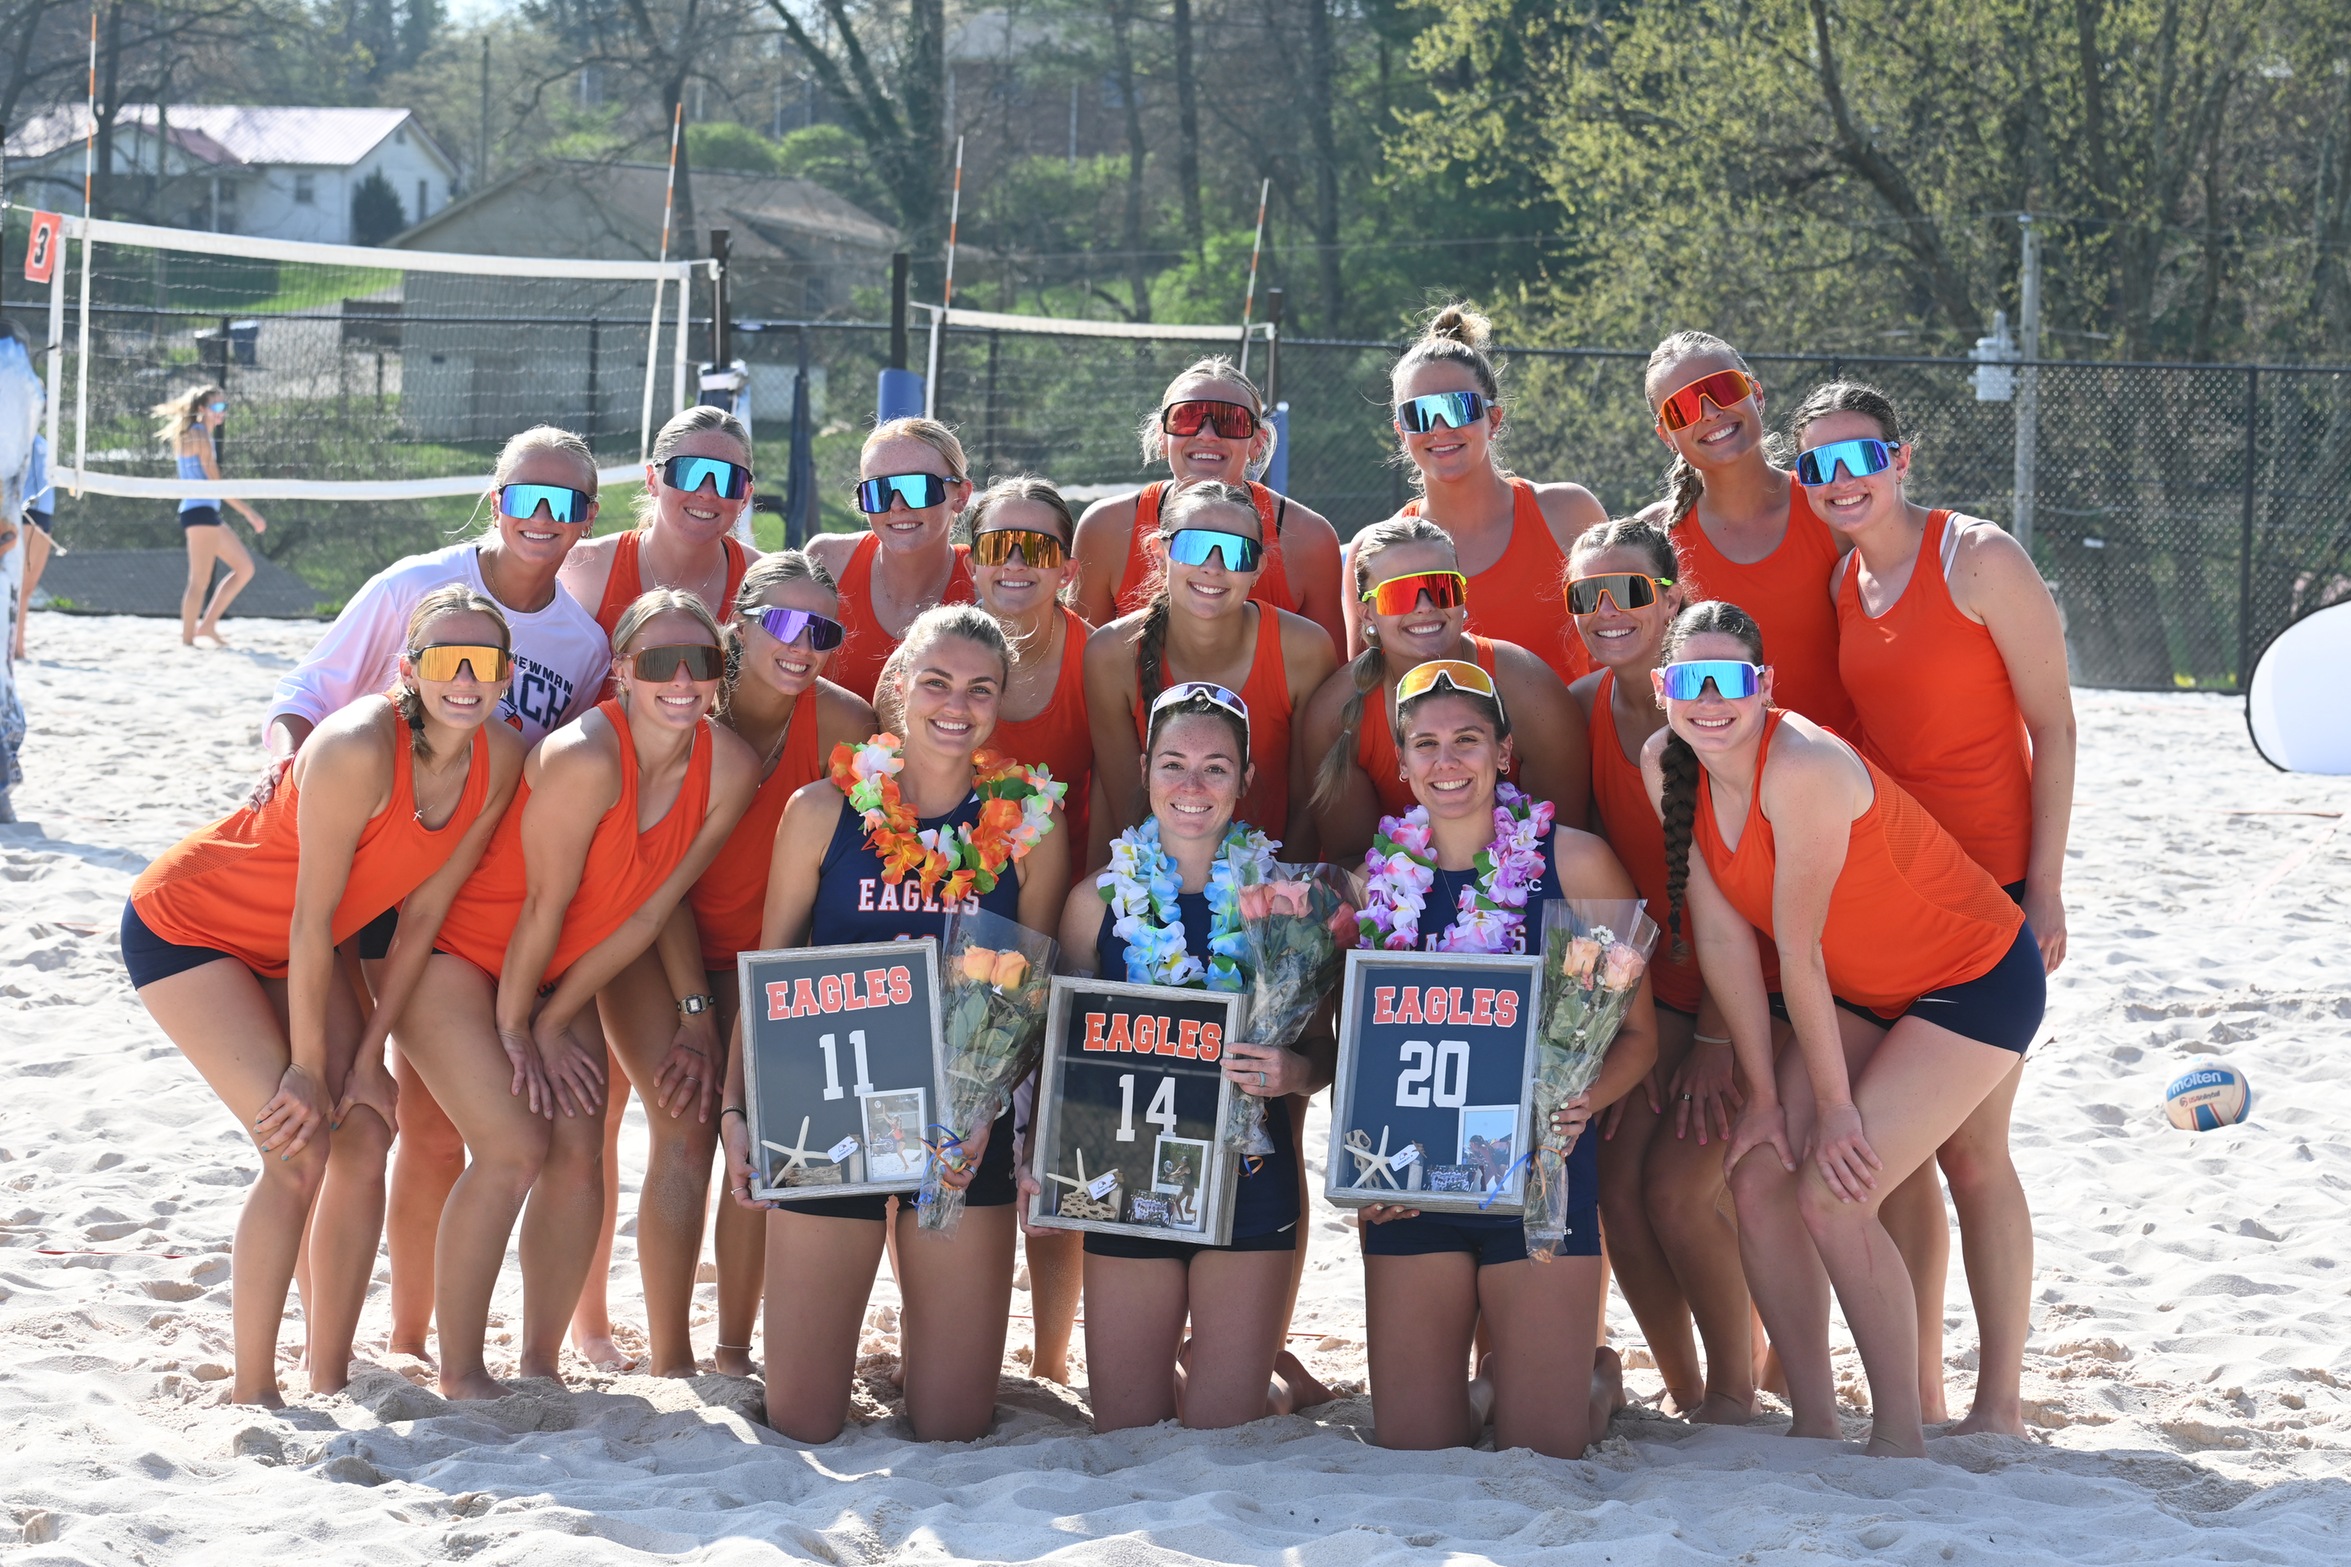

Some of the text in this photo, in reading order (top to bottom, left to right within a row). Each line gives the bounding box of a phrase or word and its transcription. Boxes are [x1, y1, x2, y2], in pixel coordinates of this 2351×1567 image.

[32, 222, 51, 268] 3
[507, 673, 572, 732] CH
[766, 966, 913, 1021] EAGLES
[1373, 986, 1519, 1028] EAGLES
[1083, 1012, 1223, 1062] EAGLES
[819, 1030, 875, 1101] 11
[1395, 1040, 1471, 1108] 20
[2172, 1071, 2222, 1095] molten
[1116, 1074, 1177, 1142] 14
